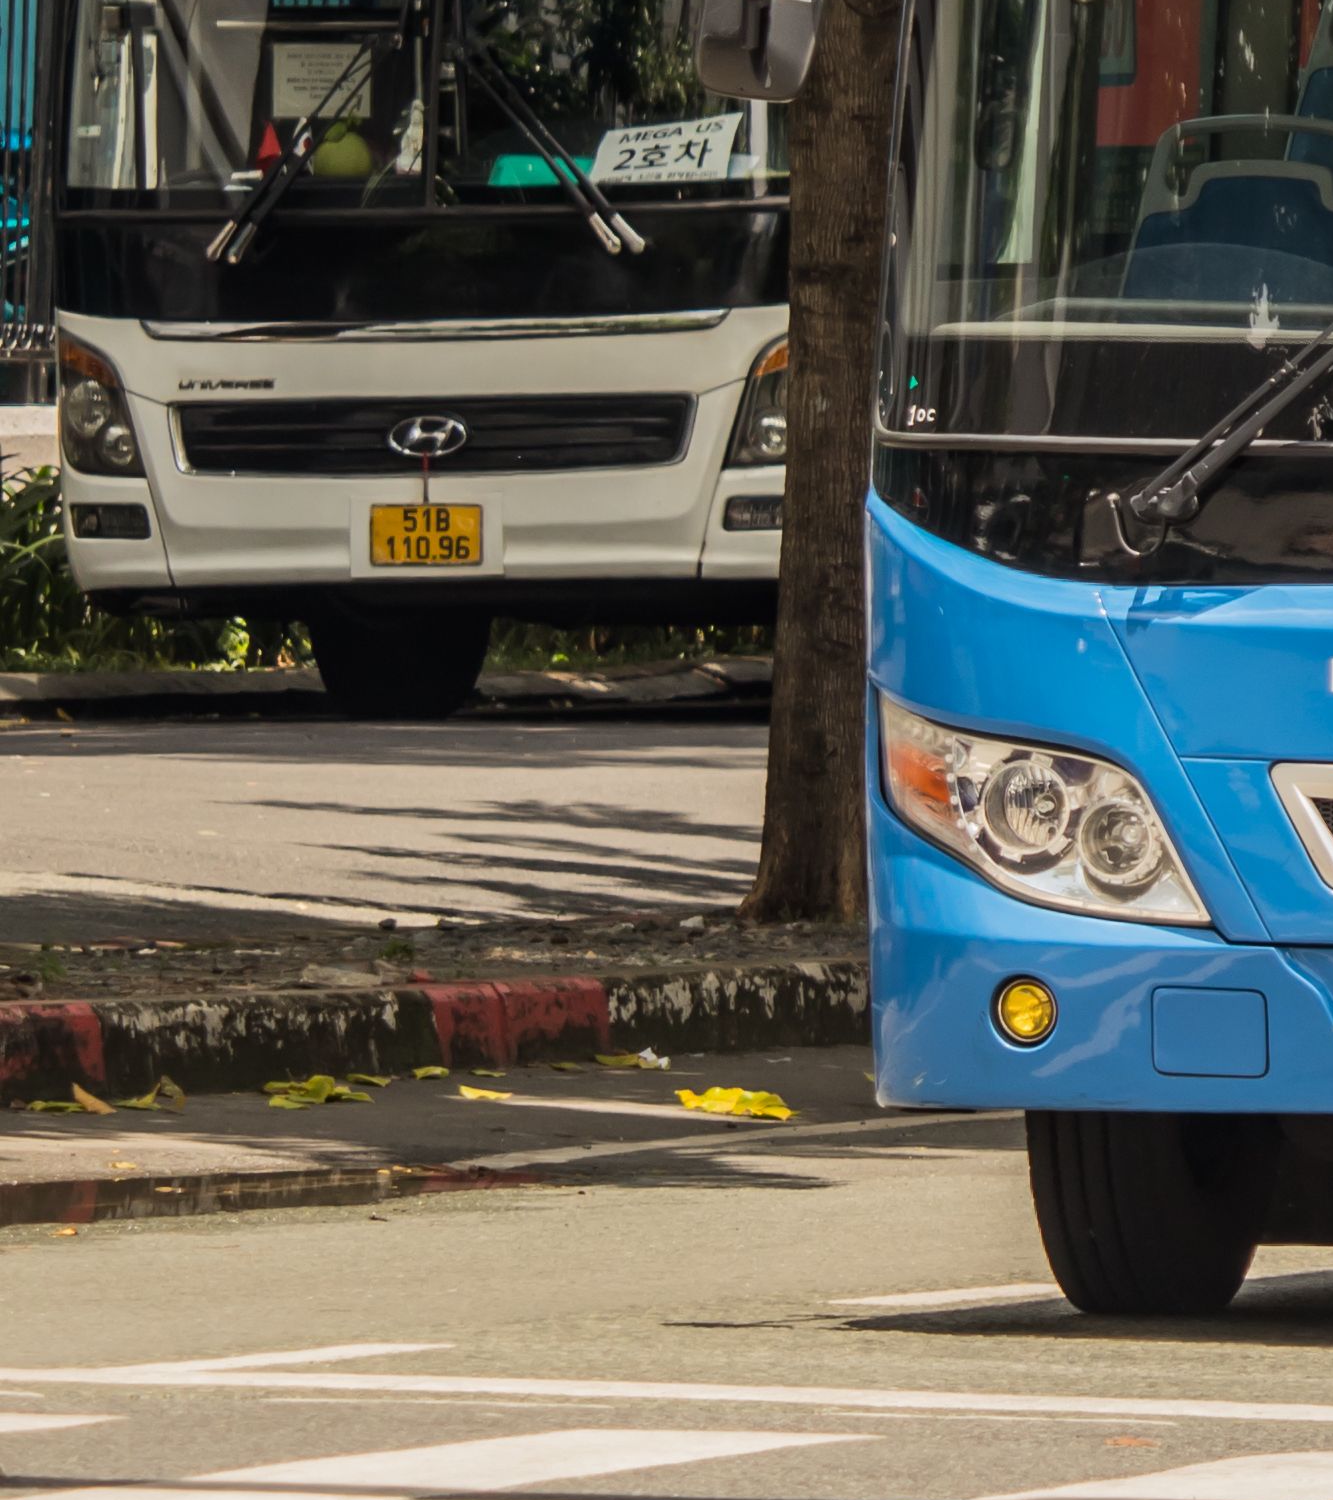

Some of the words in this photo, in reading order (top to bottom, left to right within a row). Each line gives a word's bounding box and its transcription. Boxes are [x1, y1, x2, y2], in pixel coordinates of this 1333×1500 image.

[619, 126, 683, 145] MEGA
[695, 119, 726, 134] US
[613, 138, 713, 171] 2호차
[403, 507, 450, 533] 51B
[386, 535, 470, 560] 110.96
